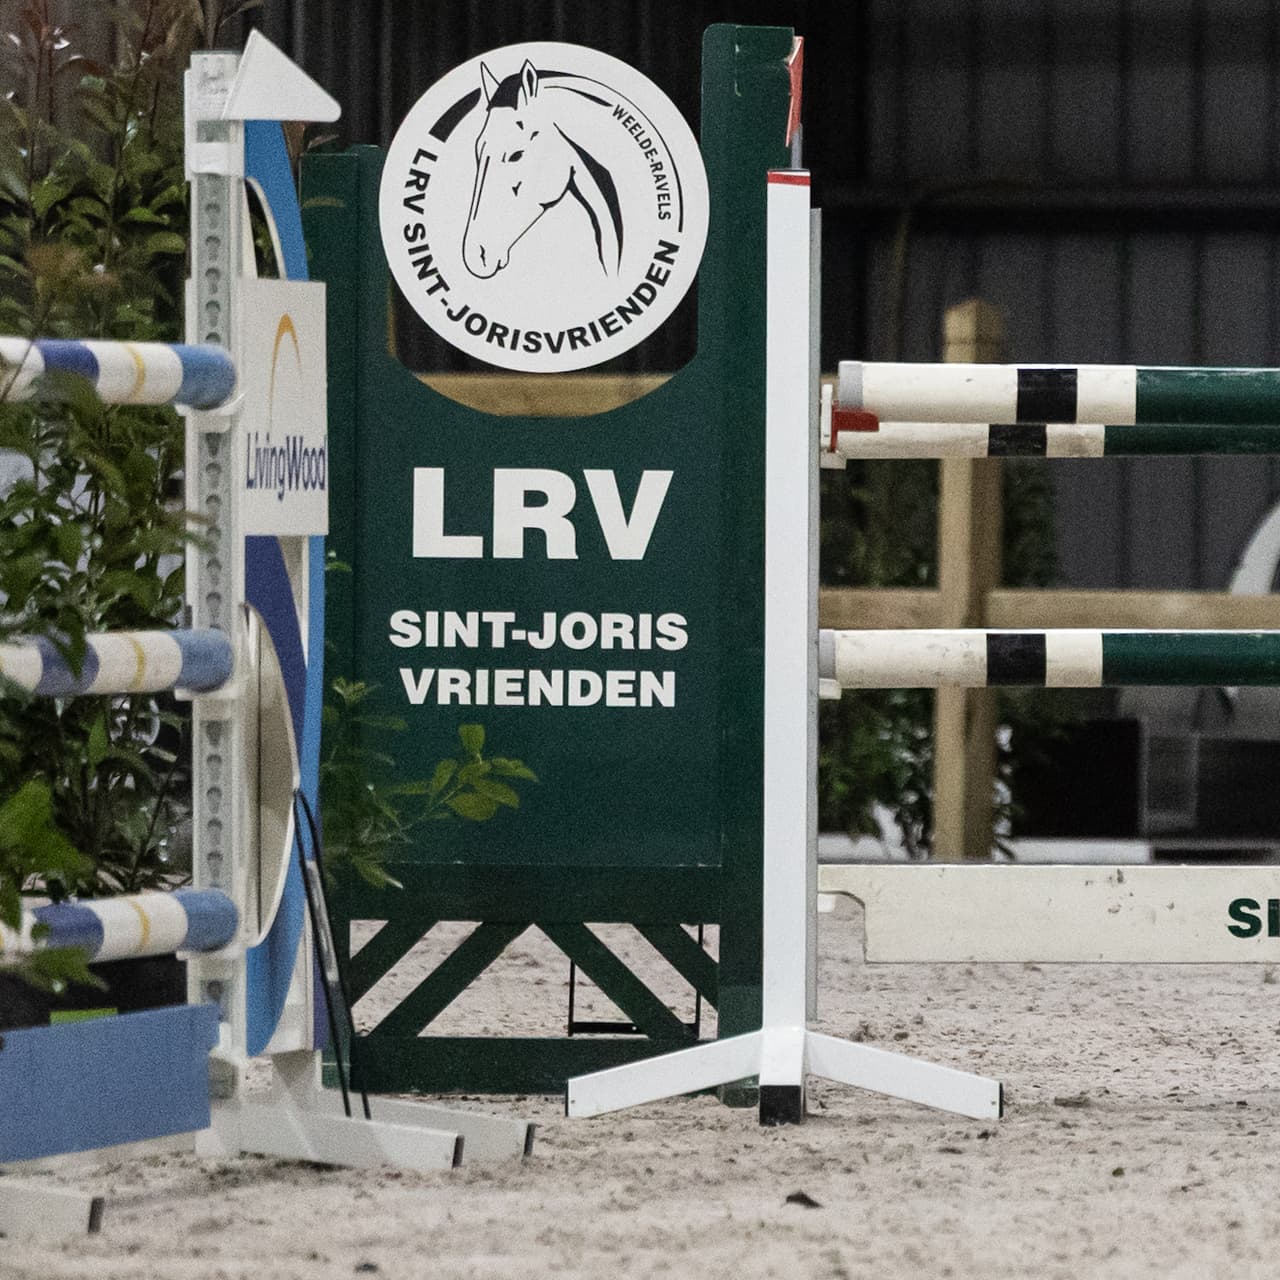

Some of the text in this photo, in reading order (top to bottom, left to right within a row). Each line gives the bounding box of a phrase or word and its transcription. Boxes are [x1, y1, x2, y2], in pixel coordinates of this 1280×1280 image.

[612, 104, 672, 221] WEELDE-RAVELS
[403, 147, 680, 354] LRV SINT-JORISVRIENDEN
[412, 467, 675, 561] LRV
[389, 609, 689, 651] SINT-JORIS
[399, 667, 676, 708] VRIENDEN
